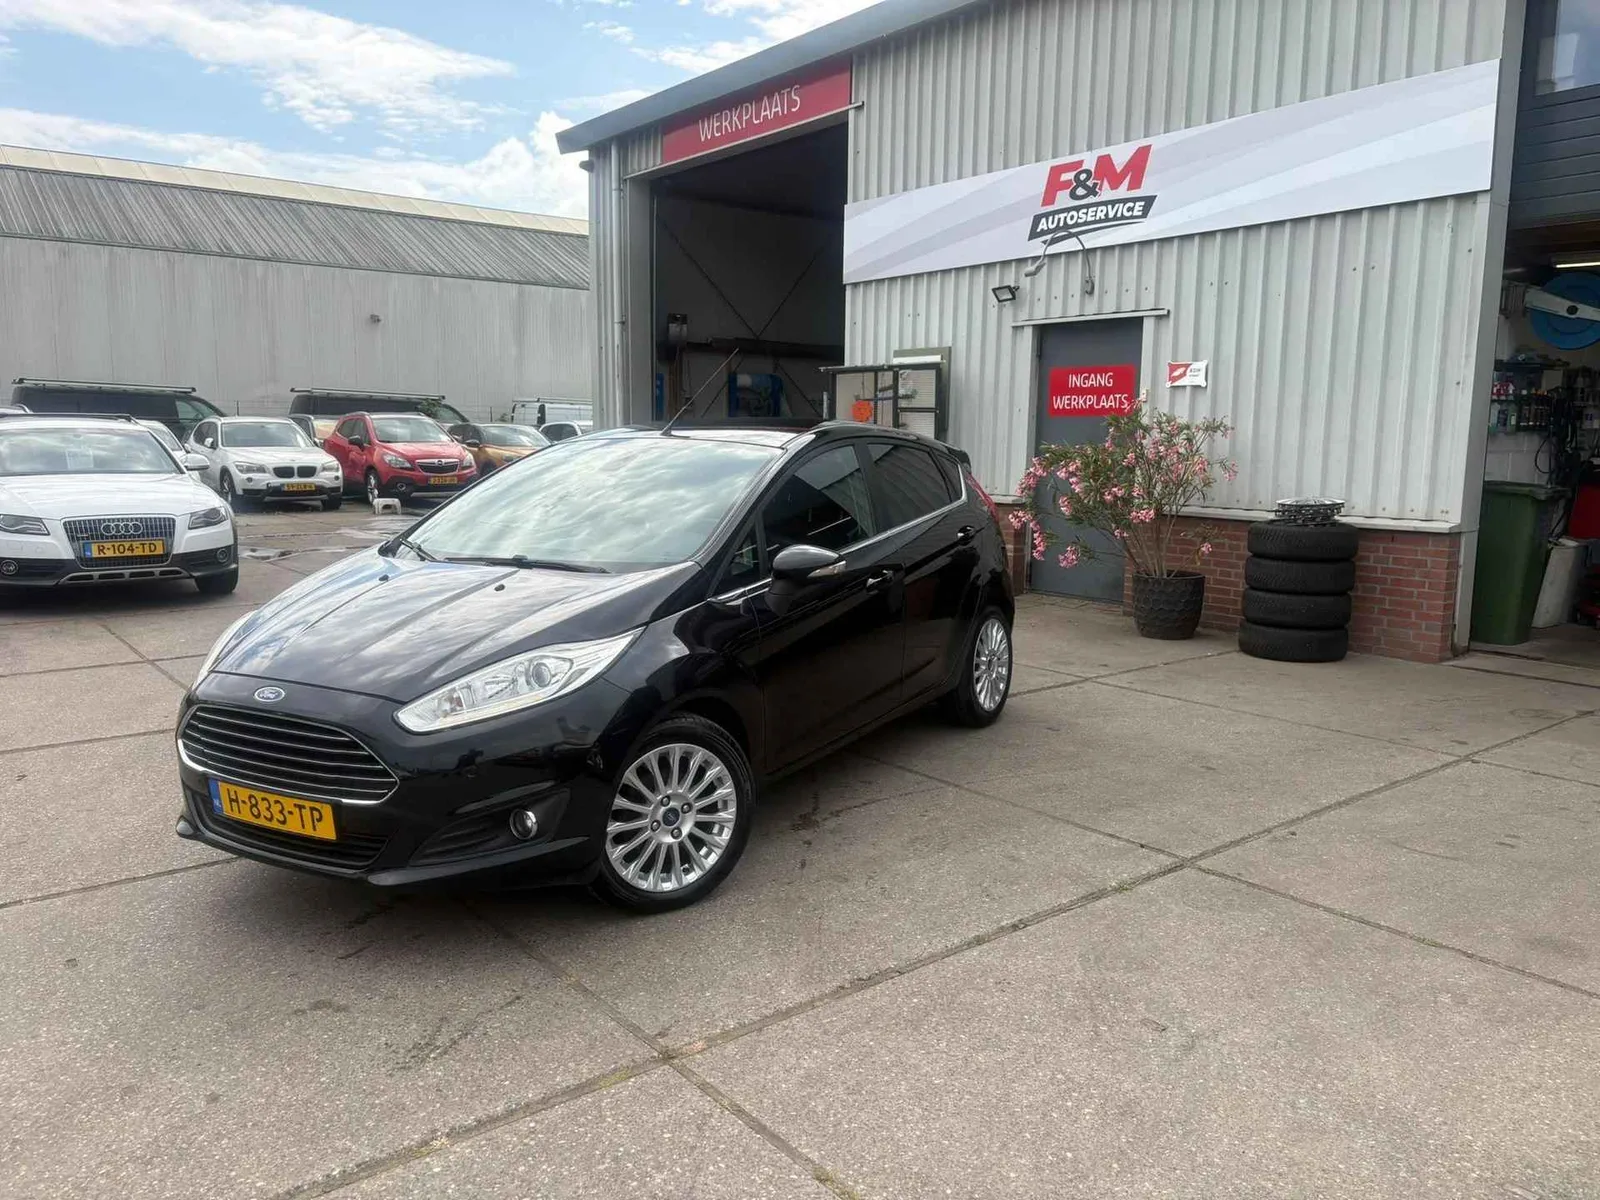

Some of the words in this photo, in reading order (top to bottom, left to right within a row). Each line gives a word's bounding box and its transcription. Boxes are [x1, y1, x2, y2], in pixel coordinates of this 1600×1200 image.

[698, 84, 801, 142] WERKPLAATS
[1041, 144, 1152, 207] F&M
[1036, 201, 1145, 232] AUTOSERVICE
[1068, 372, 1113, 388] INGANG
[1053, 394, 1129, 410] WERKPLAATS
[97, 542, 157, 556] R-104-TD
[226, 788, 323, 832] H-833-TP
